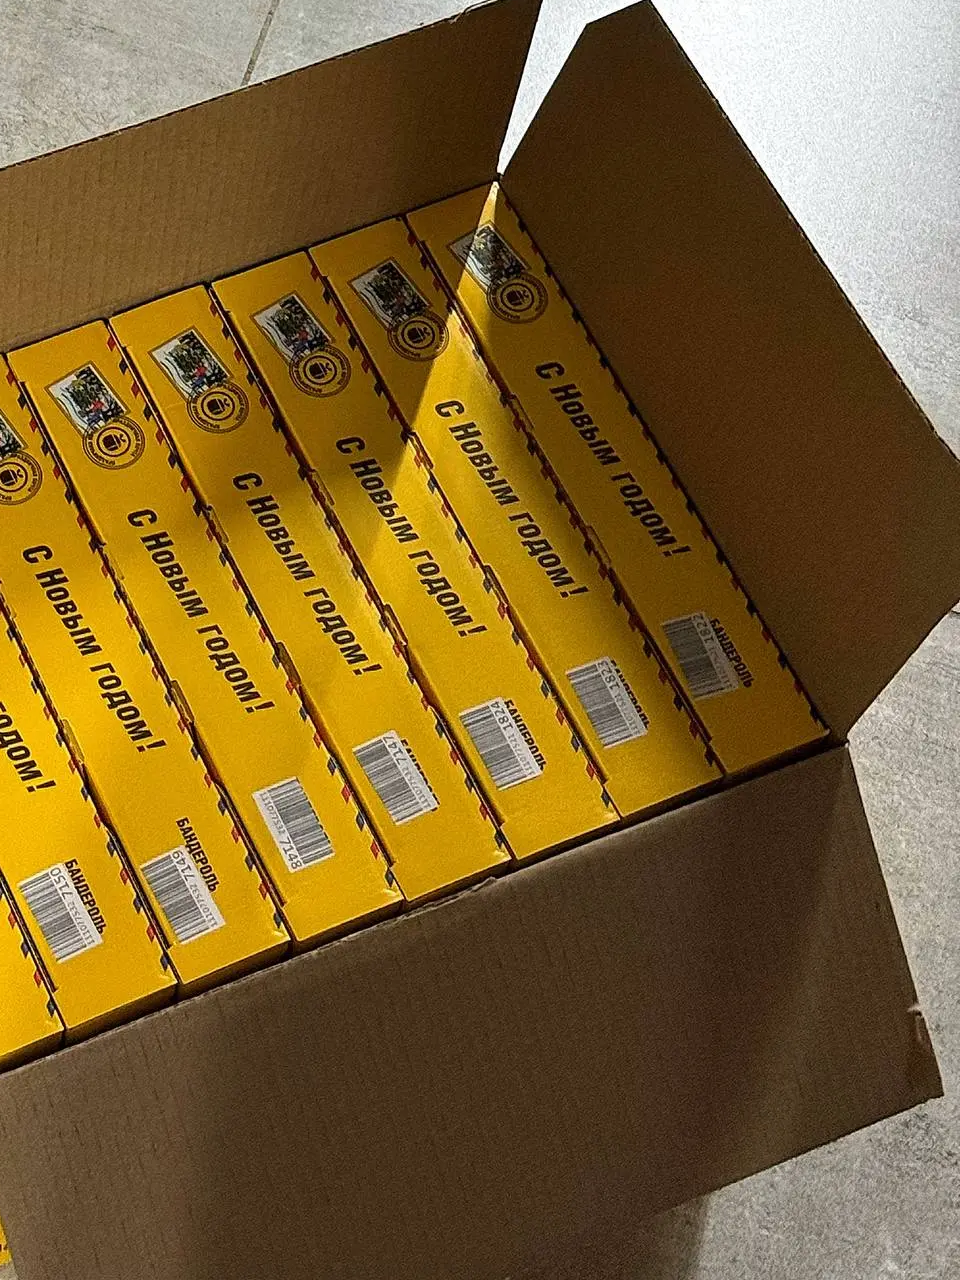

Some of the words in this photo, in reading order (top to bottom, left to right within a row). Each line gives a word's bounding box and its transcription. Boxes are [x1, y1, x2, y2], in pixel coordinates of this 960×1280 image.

[536, 362, 565, 380] С
[436, 400, 465, 418] С
[549, 383, 621, 466] Новым
[336, 437, 366, 454] С
[449, 421, 520, 506] Новым
[233, 473, 263, 491] С
[128, 509, 158, 527] С
[350, 459, 420, 544] Новым
[23, 545, 53, 564] С
[247, 495, 316, 581] Новым
[141, 532, 209, 618] Новым
[36, 568, 102, 656] Новым
[710, 618, 752, 689] БАНДЕРОЛЬ
[597, 659, 620, 691] 1823
[490, 700, 513, 732] 1824
[383, 733, 408, 765] 7147
[171, 849, 196, 884] 7149
[176, 816, 217, 892] БАНДЕРОЛЬ
[279, 837, 303, 870] 7148
[49, 866, 74, 900] 7150
[64, 858, 105, 934] БАНДЕРОЛЬ
